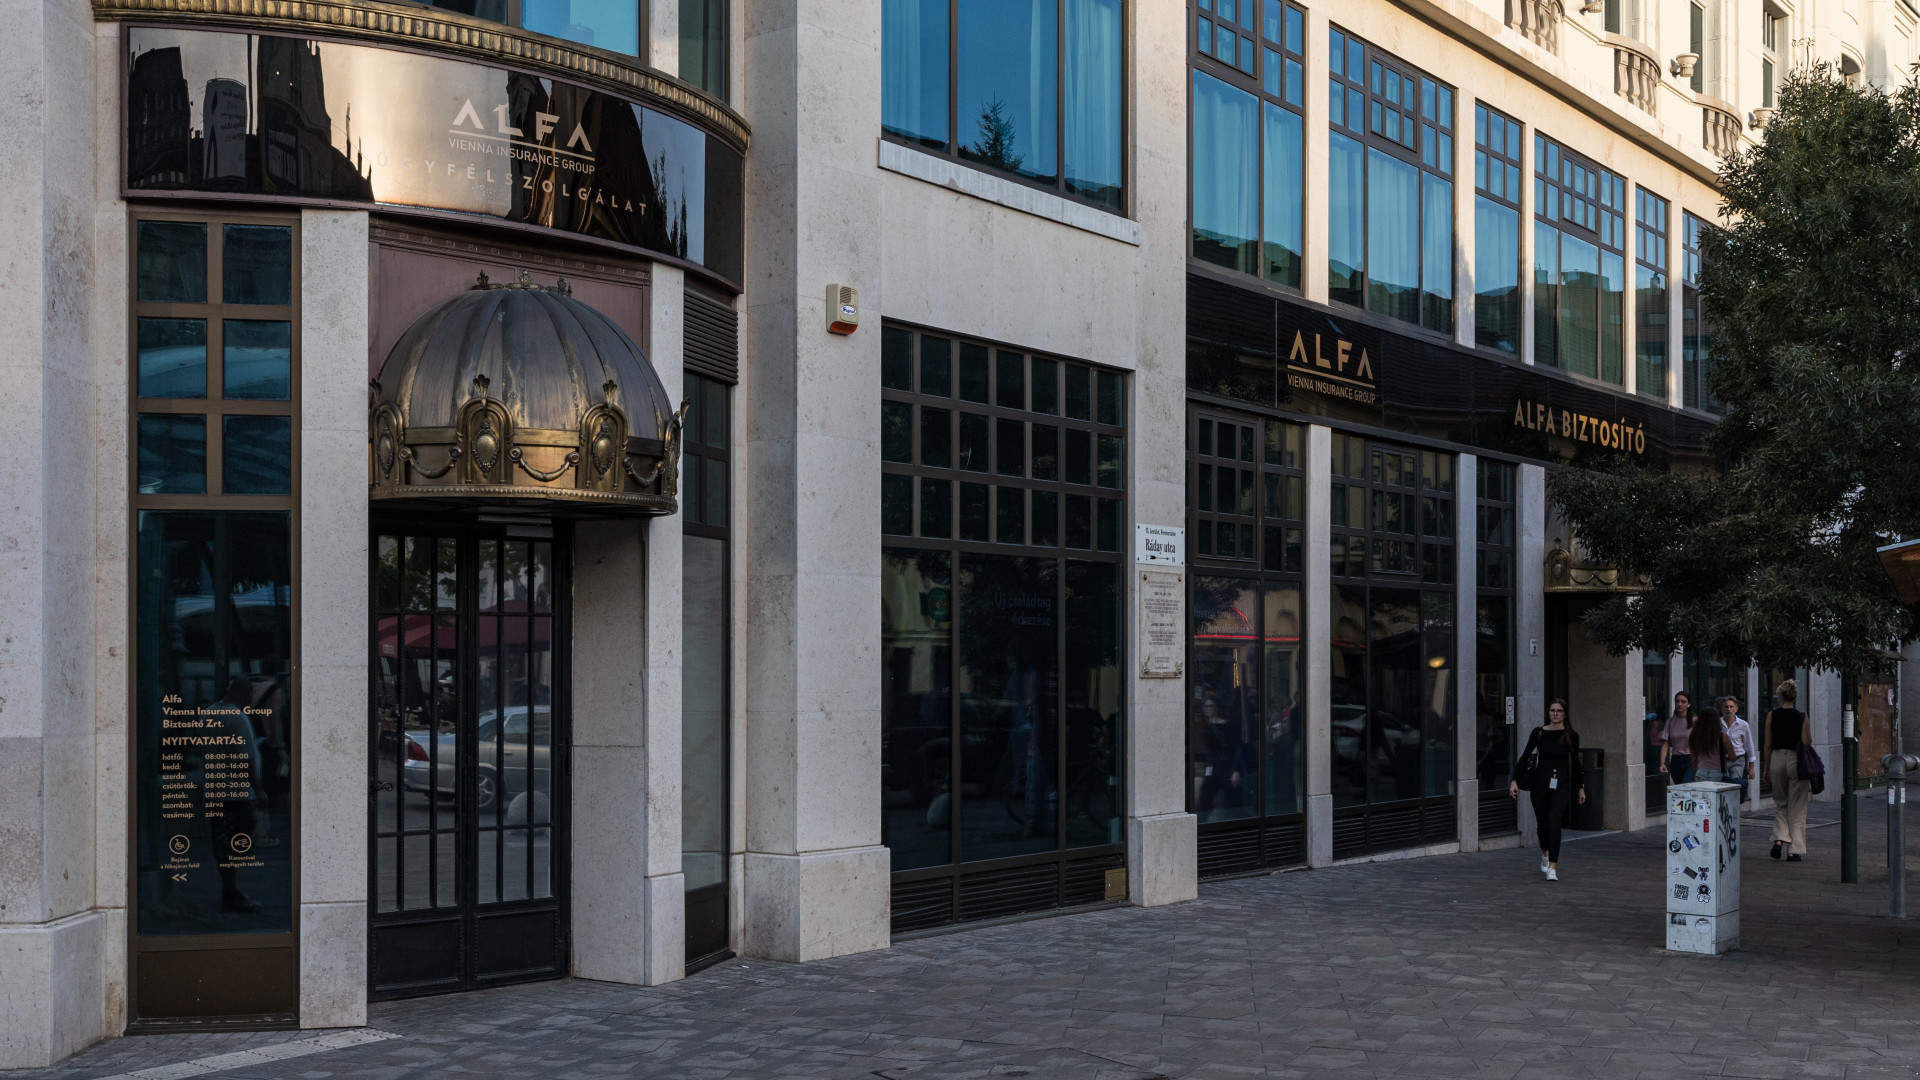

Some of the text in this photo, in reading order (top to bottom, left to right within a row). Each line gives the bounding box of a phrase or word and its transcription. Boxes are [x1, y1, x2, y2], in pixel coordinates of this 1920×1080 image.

[452, 98, 592, 152] ALFA
[449, 137, 596, 175] VIENNA INSURANCE GROUP
[376, 151, 647, 216] ÜGYFÉLSZOLGÁLAT
[1289, 329, 1374, 380] ALFA
[1287, 374, 1376, 404] VIENNA INSURANCE GROUP
[1513, 398, 1645, 455] ALFA BIZTOSÍTÓ
[1145, 538, 1176, 555] Ráday utca
[162, 694, 182, 703] Alfa
[162, 706, 272, 716] Vienna Insurance Group
[163, 719, 224, 729] Biztosító Zrt.
[162, 734, 246, 746] NYITVATARTÁS:
[162, 772, 186, 780] szerda:
[162, 791, 188, 800] péntek:
[162, 801, 193, 809] szombat:
[162, 810, 224, 819] vasárnap: zárva
